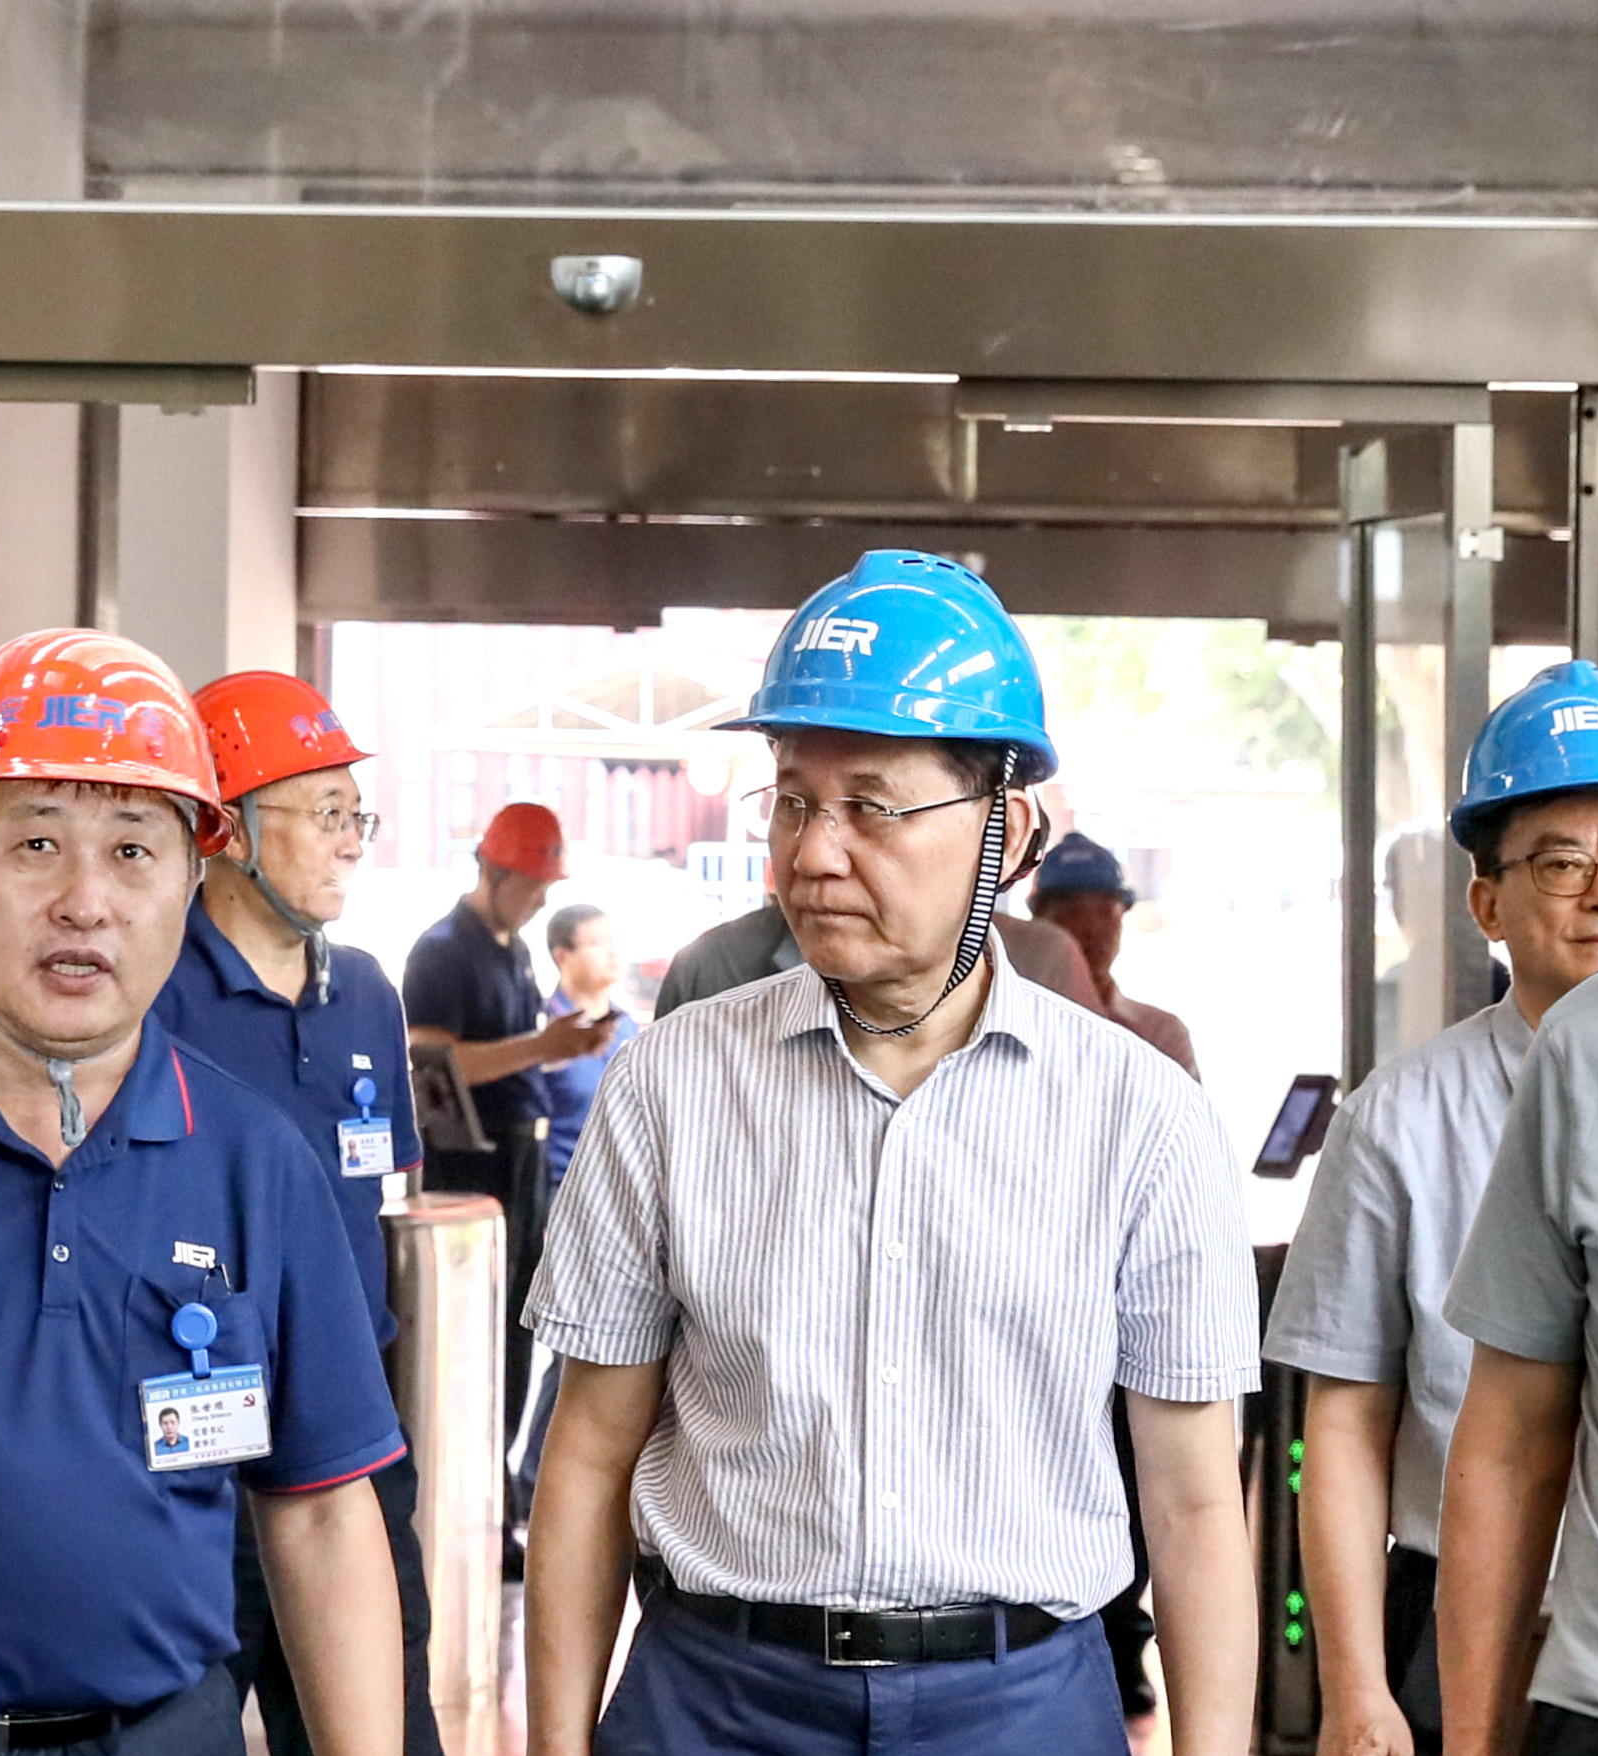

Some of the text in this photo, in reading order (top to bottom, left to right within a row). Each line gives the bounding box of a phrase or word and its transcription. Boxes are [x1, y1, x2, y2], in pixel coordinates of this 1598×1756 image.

[794, 617, 879, 656] JIER
[36, 696, 125, 733] JIER
[172, 1241, 216, 1269] JIER
